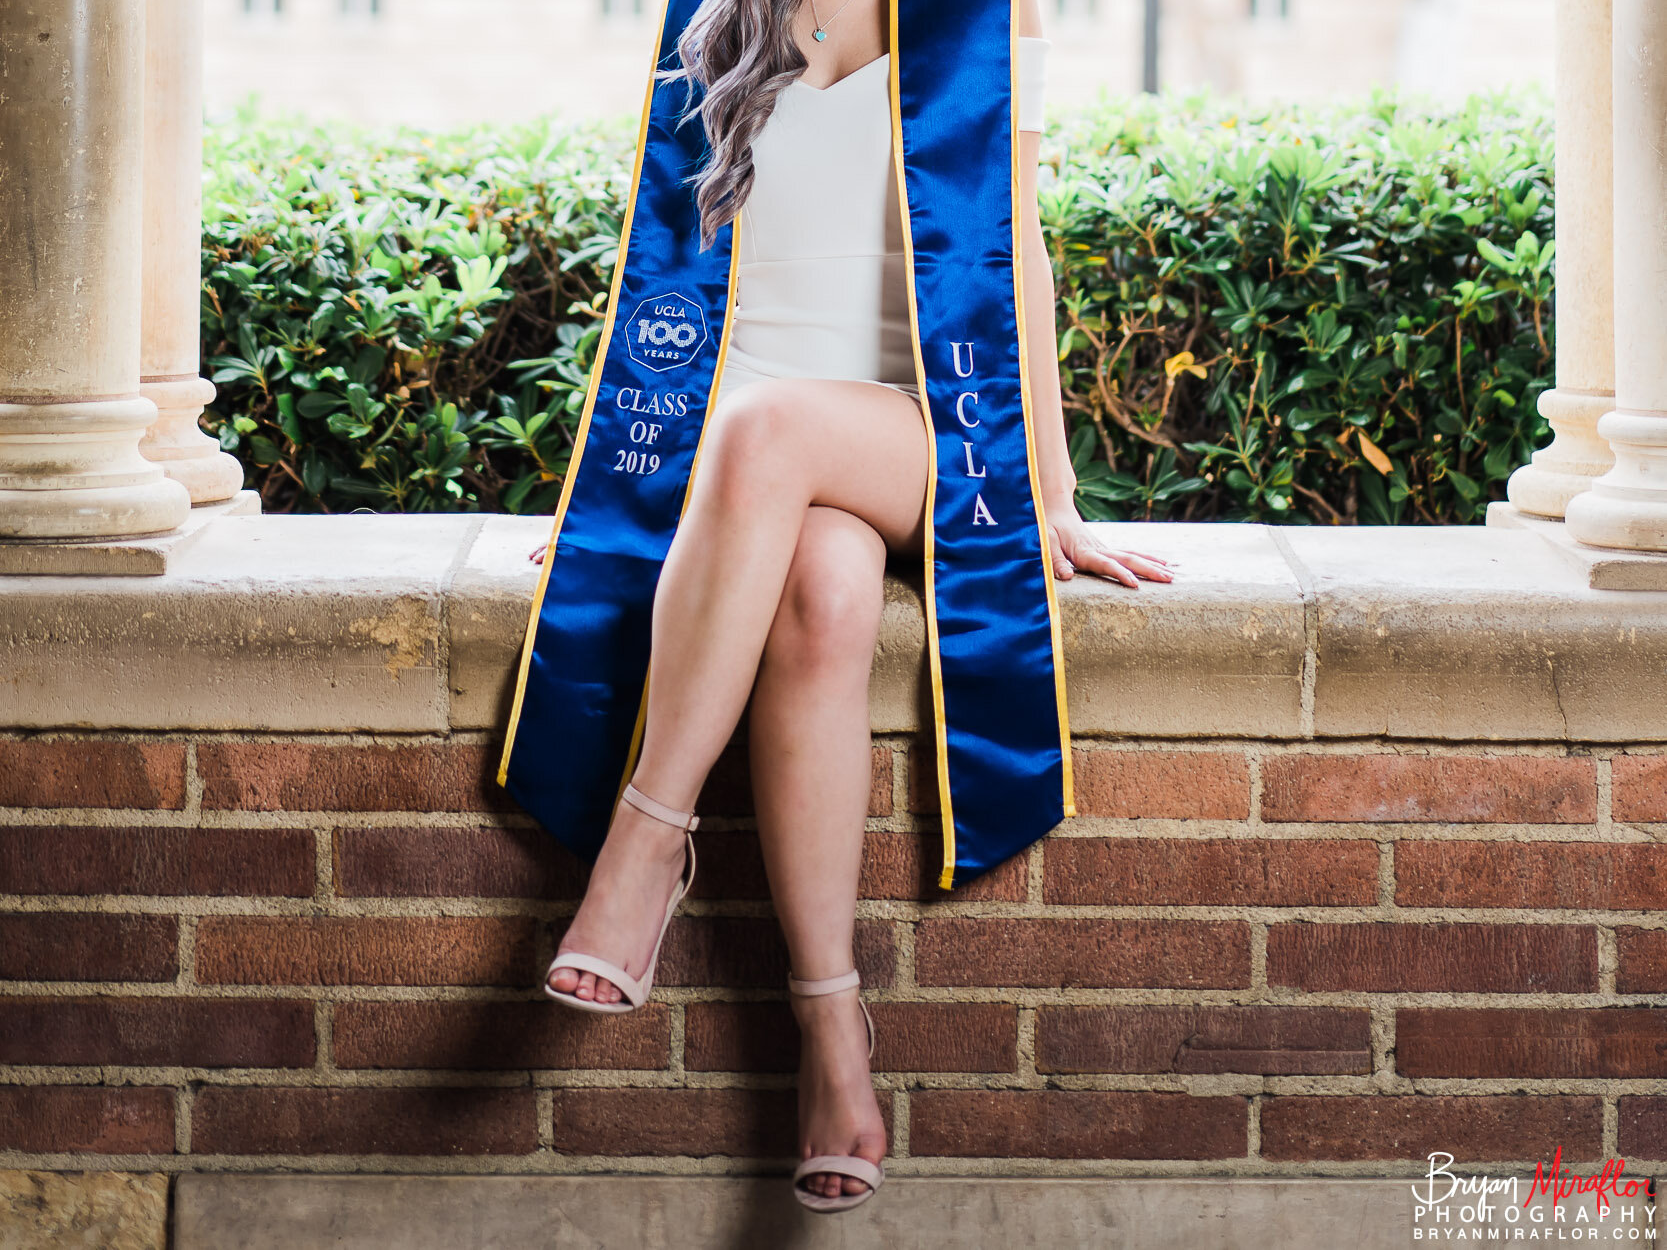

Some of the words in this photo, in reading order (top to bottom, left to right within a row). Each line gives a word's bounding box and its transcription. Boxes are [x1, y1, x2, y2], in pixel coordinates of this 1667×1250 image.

[654, 304, 686, 318] UCLA
[637, 319, 697, 347] 100
[644, 348, 680, 360] YEARS
[616, 387, 688, 417] CLASS
[629, 421, 662, 445] OF
[613, 450, 661, 475] 2019
